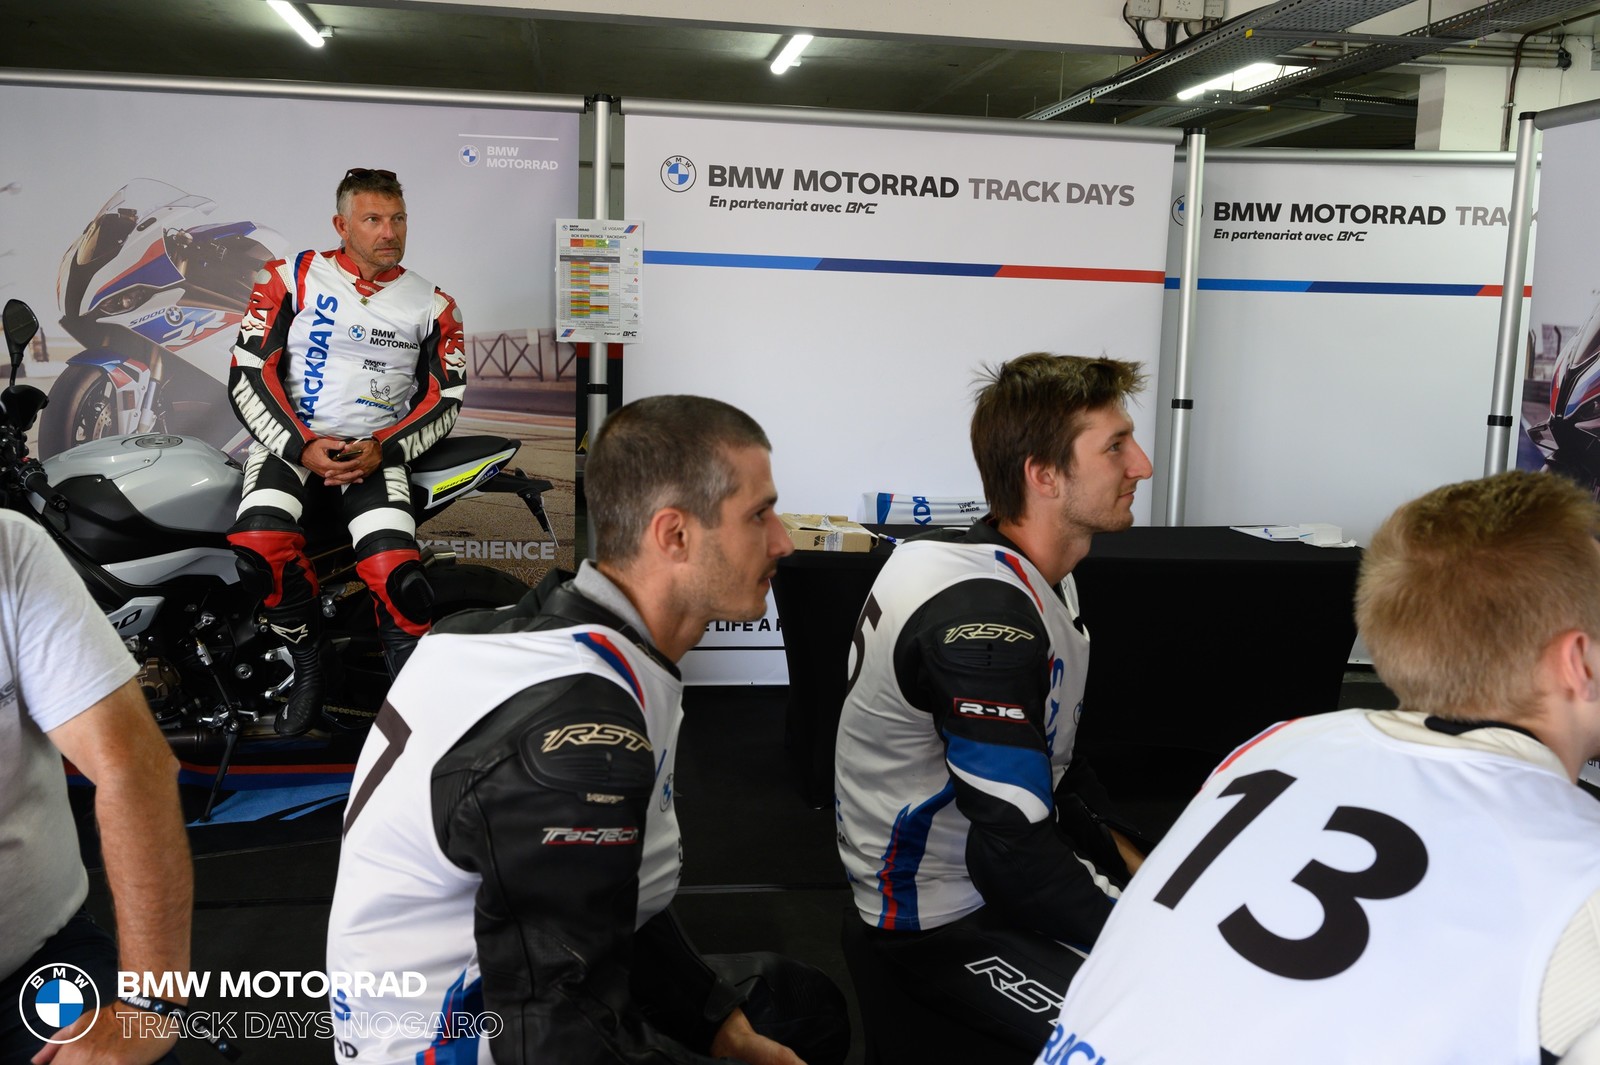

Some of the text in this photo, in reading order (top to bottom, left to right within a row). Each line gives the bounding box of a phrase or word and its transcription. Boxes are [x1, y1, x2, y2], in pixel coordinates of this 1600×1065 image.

[486, 146, 519, 156] BMW
[486, 158, 559, 170] MOTORRAD
[708, 164, 1135, 207] BMW MOTORRAD TRACK DAYS
[709, 195, 878, 214] En partenariat avec BMC
[1213, 202, 1538, 227] BMW MOTORRAD TRA
[1213, 229, 1367, 242] En partenariat avec BMC
[371, 328, 396, 339] BMW
[369, 337, 419, 350] MOTORRAD
[232, 371, 291, 458] YAMAHA
[398, 403, 458, 463] YAMAHA
[758, 618, 771, 631] A
[944, 623, 1035, 644] RST
[960, 702, 1025, 719] R-16
[541, 723, 654, 752] RST
[1153, 769, 1429, 981] 13
